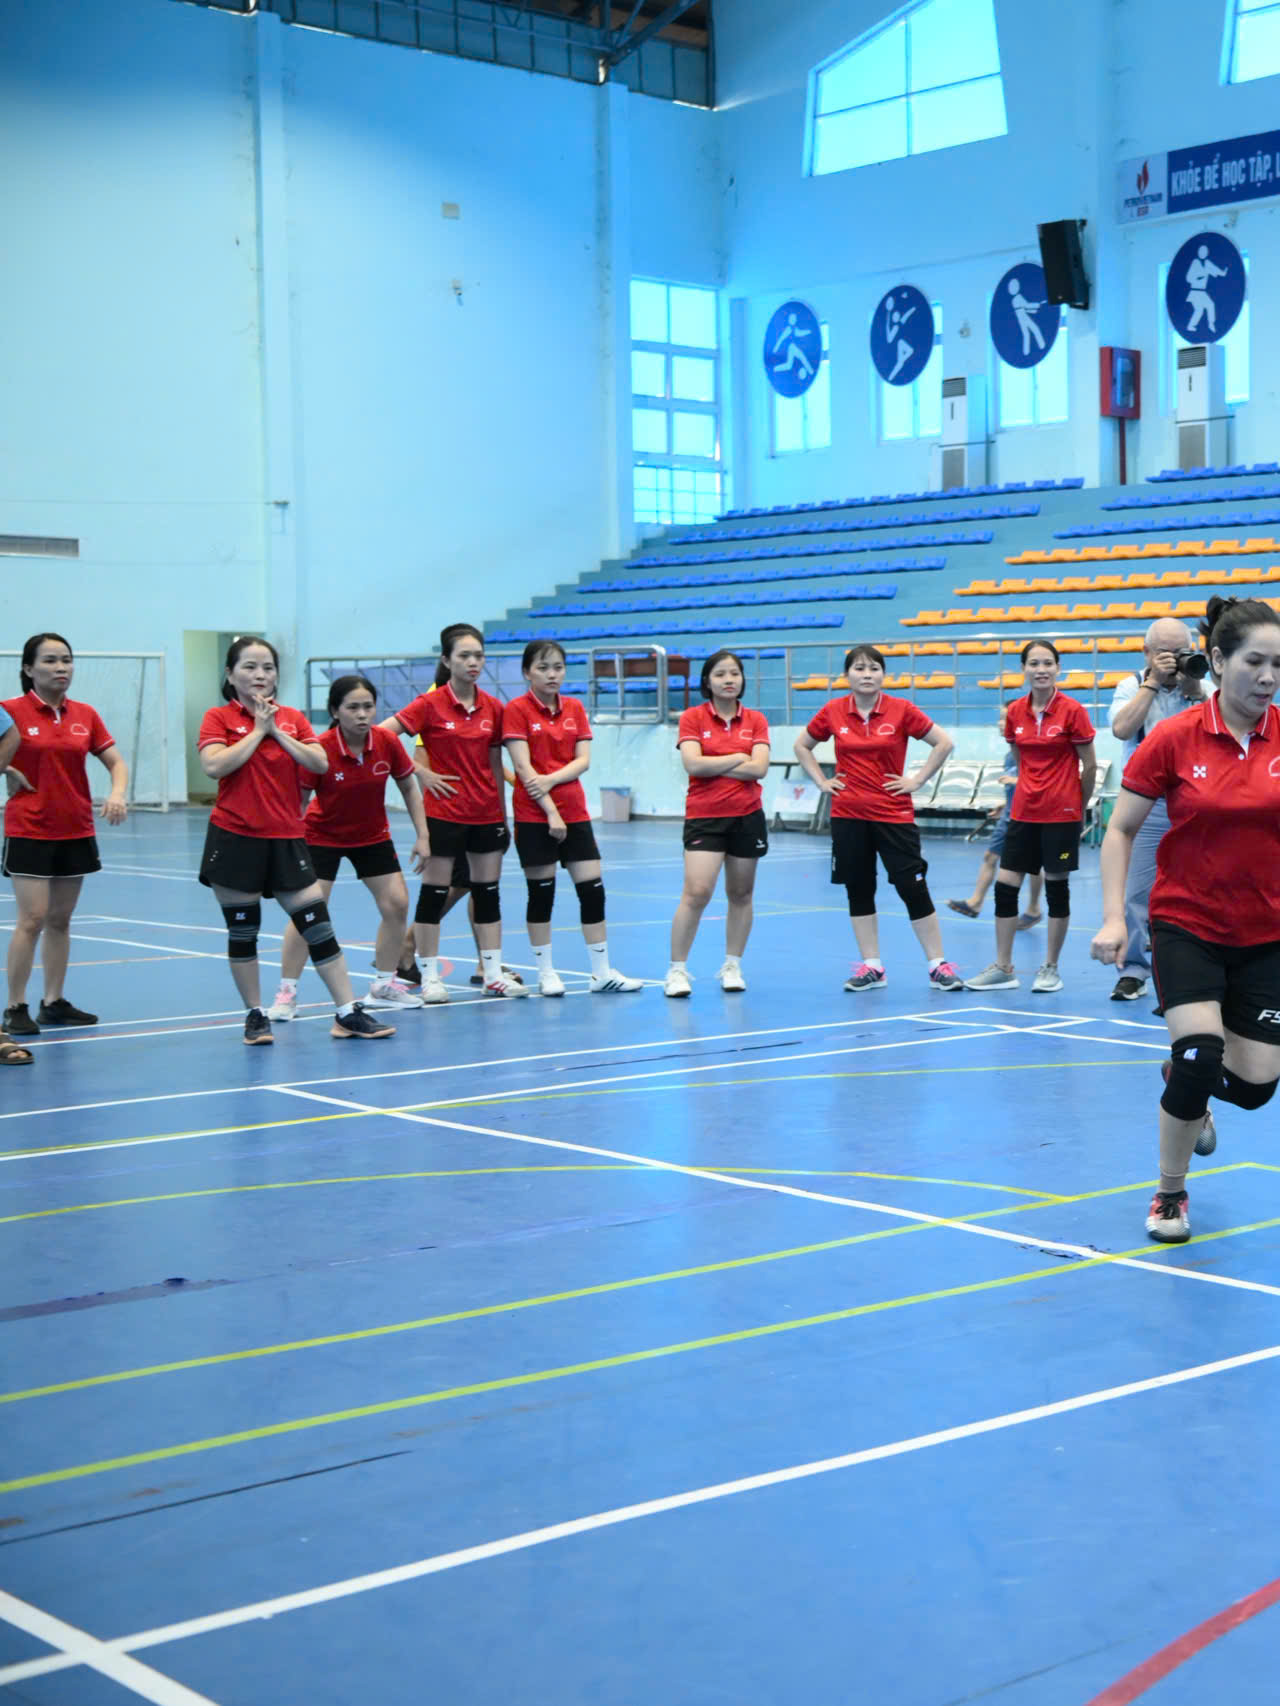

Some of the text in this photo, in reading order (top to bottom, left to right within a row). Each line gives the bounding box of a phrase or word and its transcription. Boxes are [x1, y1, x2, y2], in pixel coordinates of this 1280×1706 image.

[1171, 160, 1201, 197] KHỎE
[1222, 158, 1246, 192] HỌC
[1248, 150, 1273, 187] TẬP,
